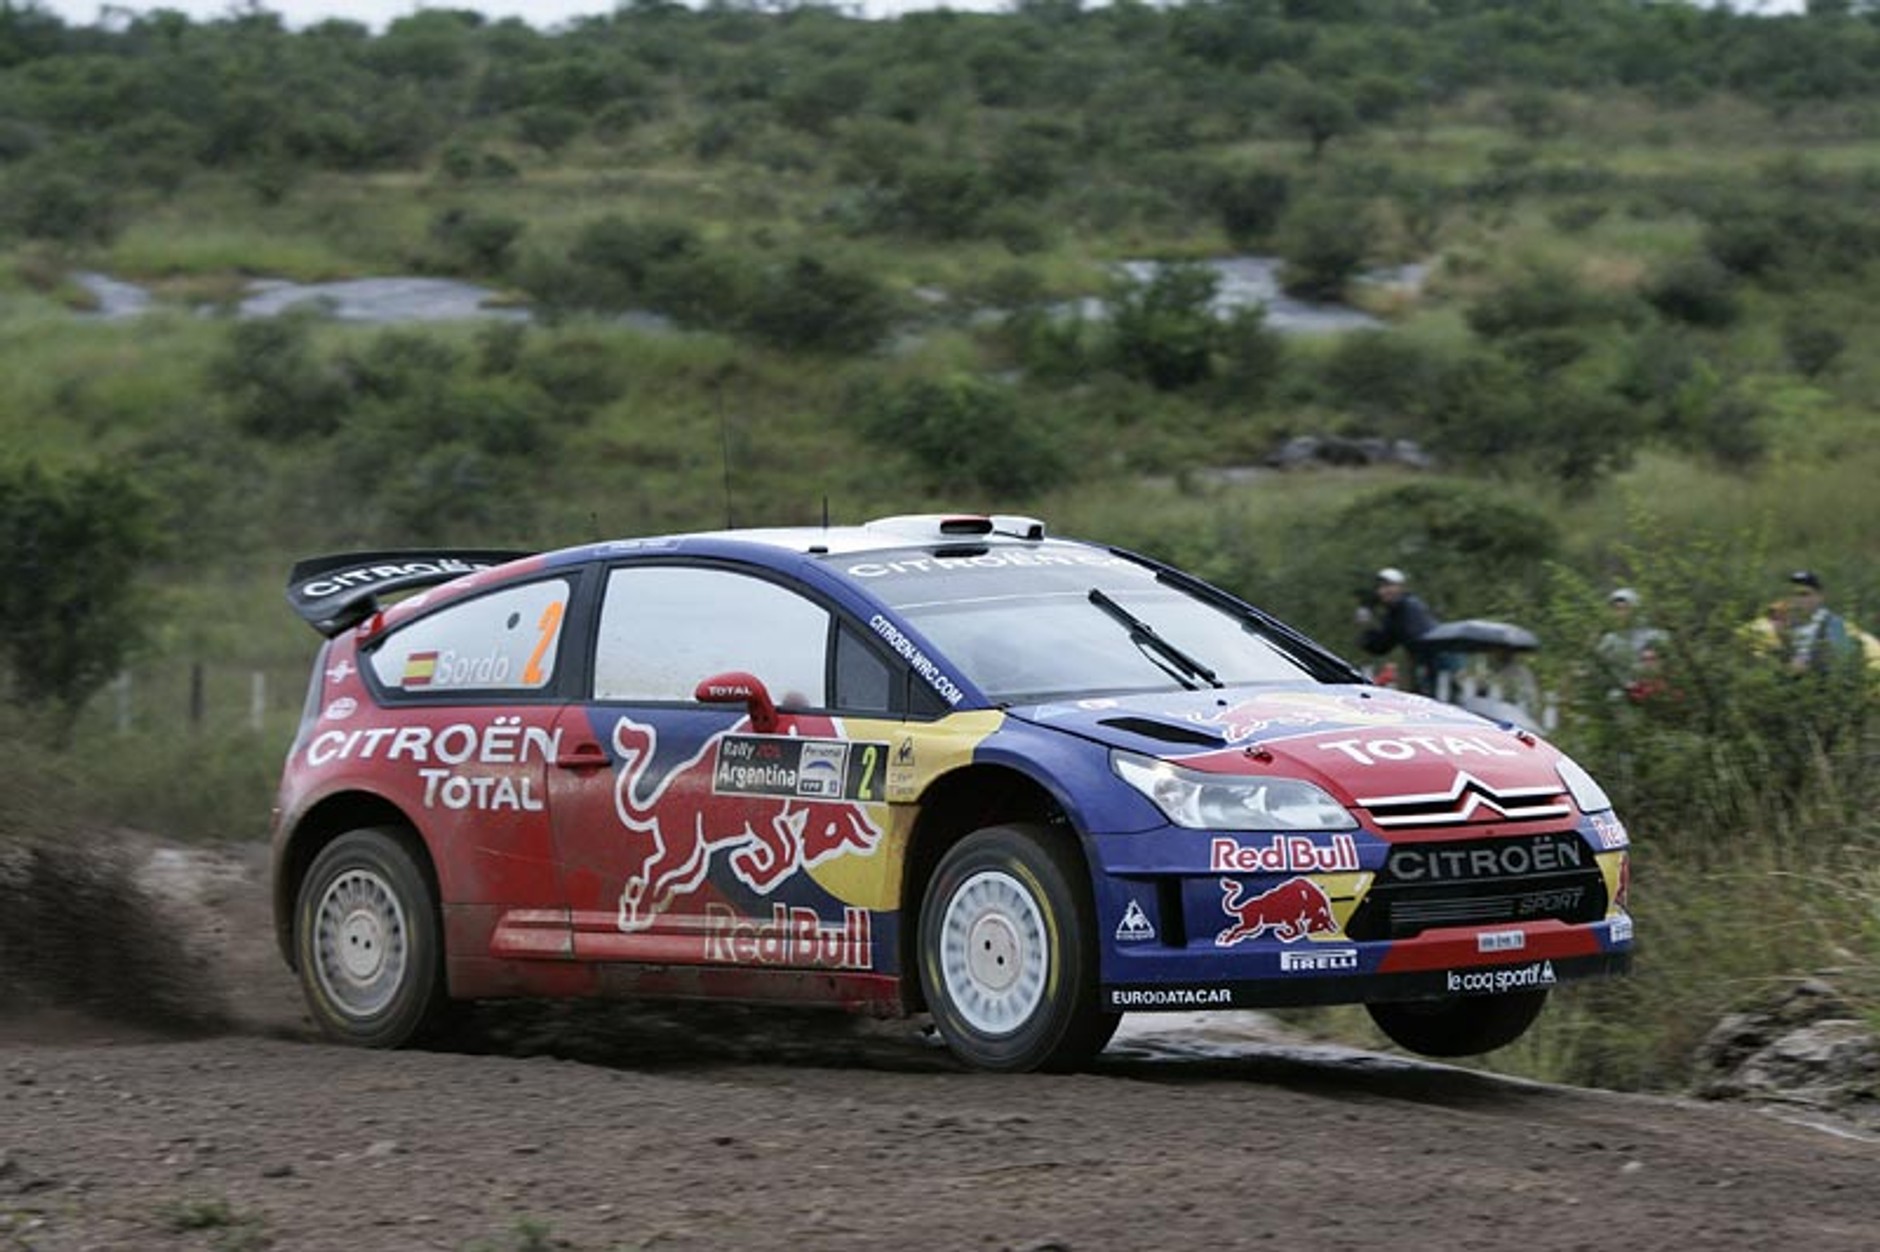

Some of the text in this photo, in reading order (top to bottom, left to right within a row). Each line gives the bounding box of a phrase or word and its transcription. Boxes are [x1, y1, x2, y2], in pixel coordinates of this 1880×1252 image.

[521, 602, 563, 684] 2
[436, 653, 511, 685] Sordo
[708, 685, 752, 697] TOTAL
[306, 716, 564, 767] CITROËN
[722, 740, 756, 760] Rally
[1319, 735, 1519, 765] TOTAL
[718, 760, 797, 789] Argentina
[858, 745, 878, 800] 2
[418, 768, 544, 811] TOTAL
[1210, 834, 1360, 873] Red Bull
[1388, 836, 1582, 880] CITROËN
[704, 902, 873, 970] Red Bull
[1280, 949, 1358, 971] PIRELLI
[1447, 963, 1541, 993] le coq sportif
[1111, 989, 1232, 1005] EURODATACAR
